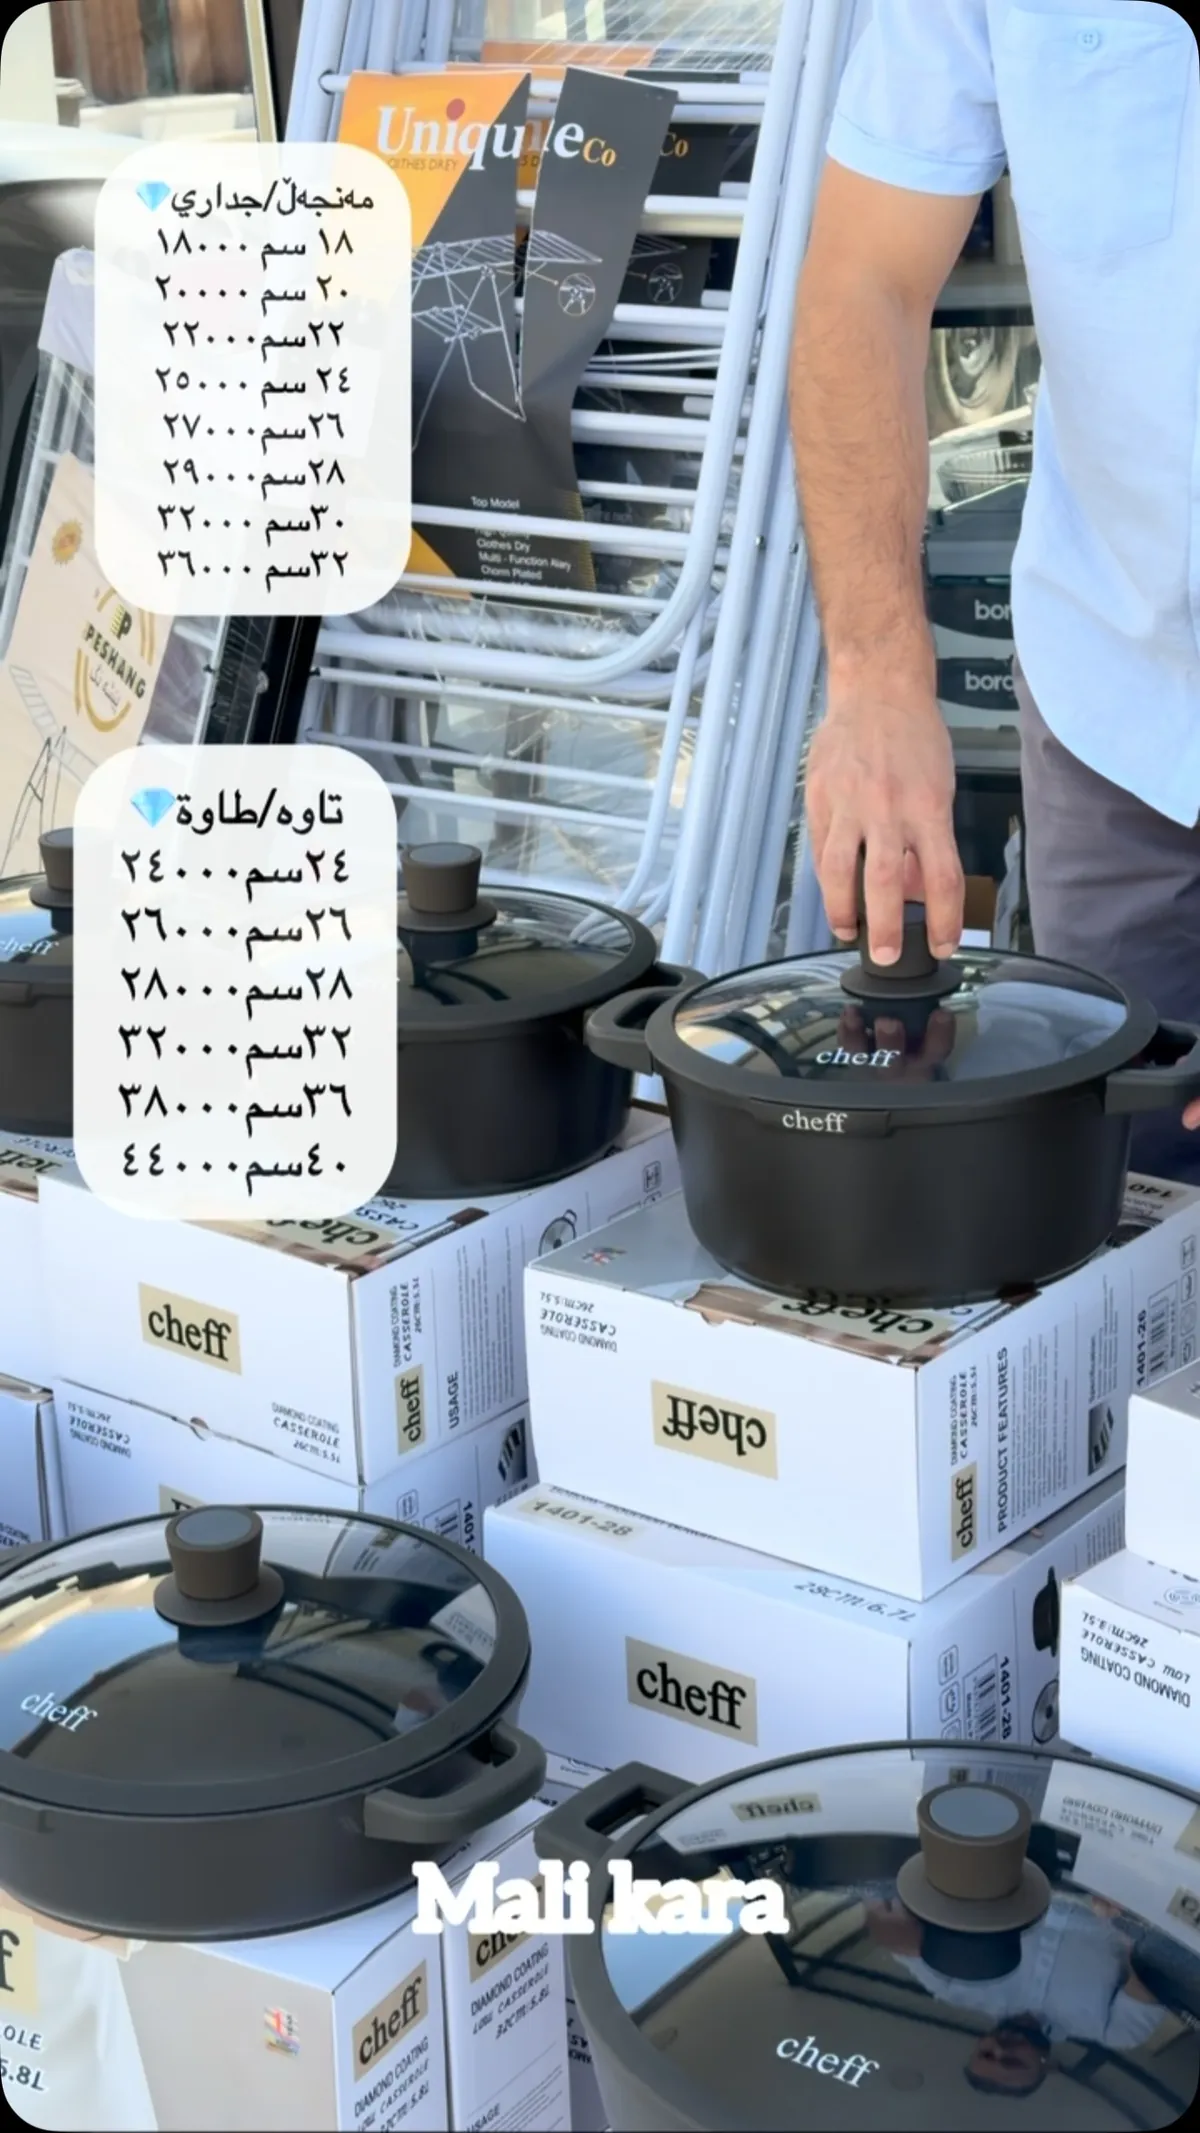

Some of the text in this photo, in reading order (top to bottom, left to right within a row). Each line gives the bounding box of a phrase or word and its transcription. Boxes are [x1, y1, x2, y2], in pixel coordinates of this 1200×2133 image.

[471, 496, 520, 510] Top Model
[509, 554, 549, 567] Function
[84, 622, 146, 699] PESHANG
[816, 1046, 900, 1068] cheff
[782, 1110, 848, 1133] cheff
[147, 1303, 233, 1362] cheff
[540, 1308, 618, 1338] CASSEROLE
[400, 1375, 422, 1443] cheff
[446, 1371, 461, 1431] USAGE
[661, 1394, 767, 1457] cheff
[272, 1416, 341, 1449] CASSEROLE
[997, 1347, 1009, 1533] PRODUCT FEATURES
[533, 1499, 634, 1538] 1401-28
[956, 1473, 974, 1549] cheff
[1080, 1646, 1191, 1709] DIAMOND COATING
[1081, 1627, 1191, 1685] LOW CASSEROLE
[20, 1691, 98, 1733] cheff
[636, 1660, 747, 1731] cheff
[470, 1976, 513, 2017] DIAMOND
[513, 1942, 549, 1982] COATING
[358, 1975, 422, 2066] cheff
[353, 2036, 430, 2119] DIAMOND COATING
[776, 2035, 880, 2088] cheff
